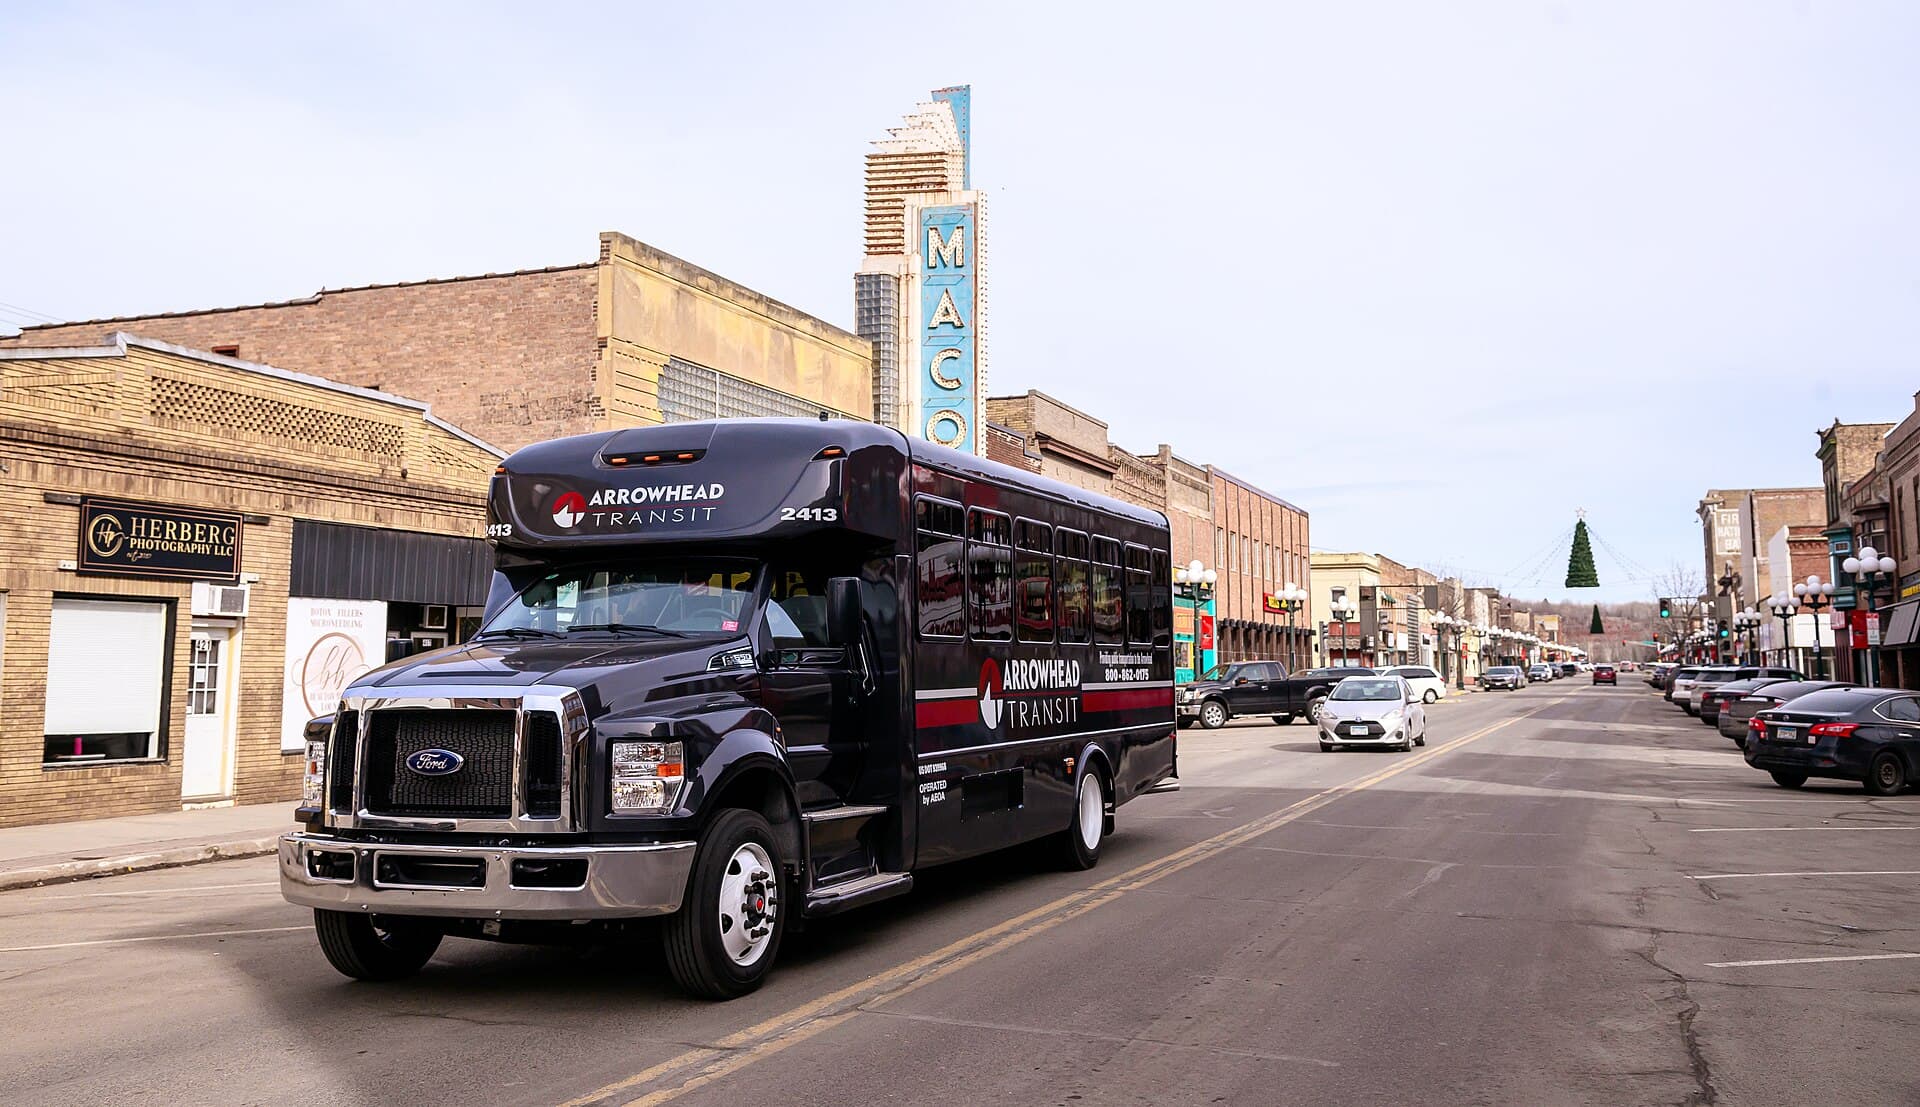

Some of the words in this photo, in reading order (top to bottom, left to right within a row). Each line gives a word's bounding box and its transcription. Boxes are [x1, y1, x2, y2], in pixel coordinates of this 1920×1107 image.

[926, 225, 967, 449] MACO
[589, 483, 725, 506] ARROWHEAD
[592, 507, 717, 527] TRANSIT
[780, 507, 838, 522] 2413
[129, 516, 235, 546] HERBERG
[129, 538, 212, 555] PHOTOGRAPHY
[213, 545, 234, 557] LLC
[1002, 659, 1080, 690] ARROWHEAD
[1007, 697, 1078, 729] TRANSIT
[416, 753, 449, 769] Ford
[919, 779, 947, 793] OPERATED
[922, 794, 930, 806] by
